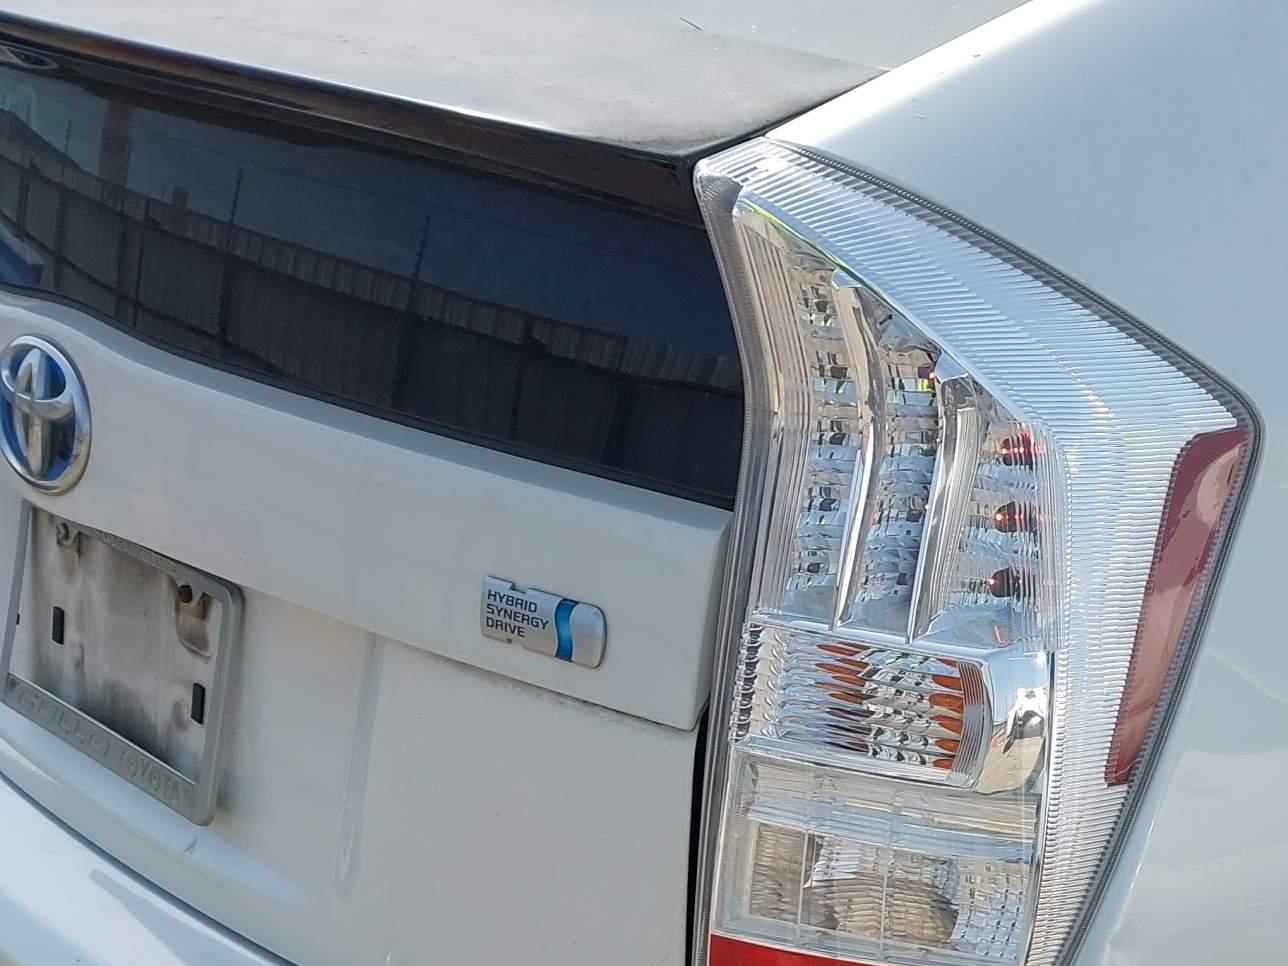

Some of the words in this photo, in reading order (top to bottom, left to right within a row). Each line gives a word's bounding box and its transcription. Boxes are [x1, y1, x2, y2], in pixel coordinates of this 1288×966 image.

[487, 588, 538, 613] HYBRID
[486, 603, 549, 630] SYNERGY
[486, 617, 526, 638] DRIVE
